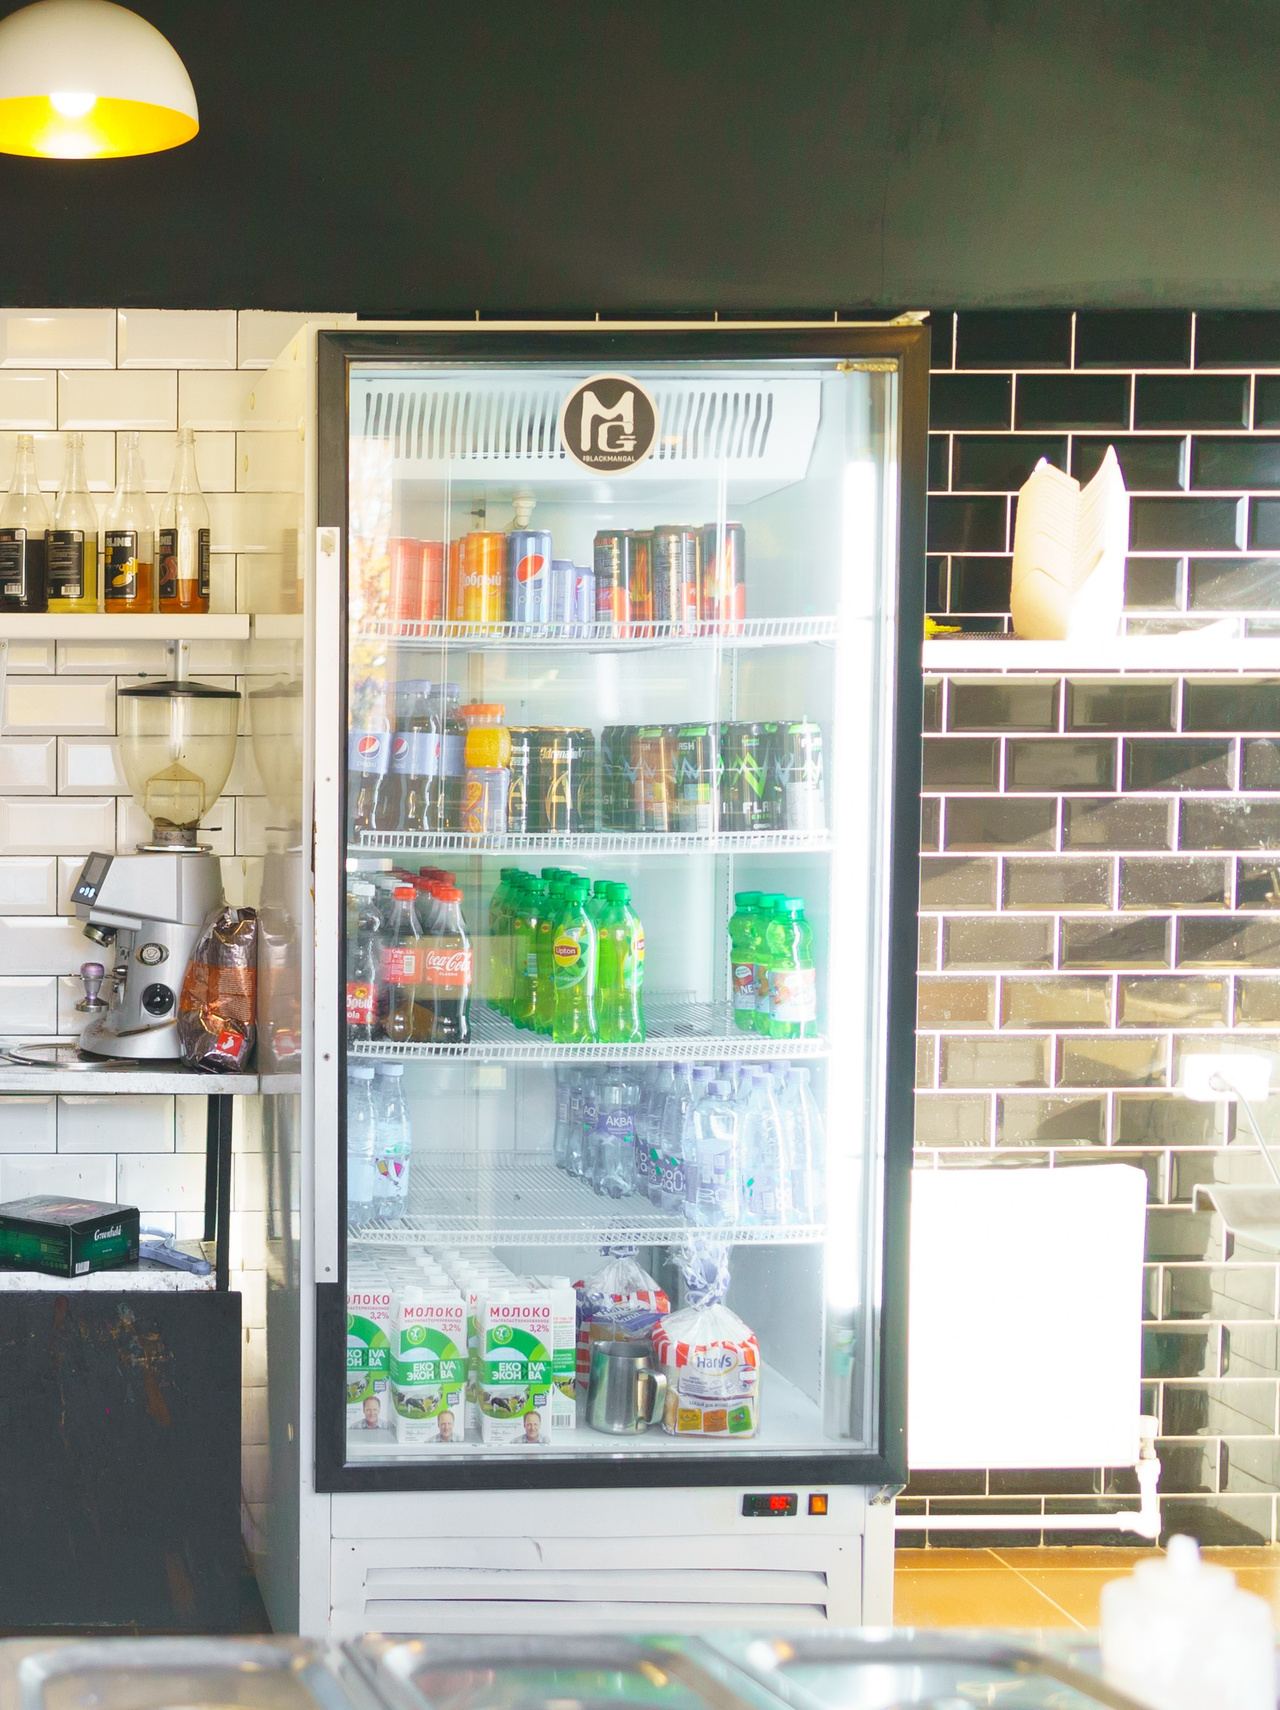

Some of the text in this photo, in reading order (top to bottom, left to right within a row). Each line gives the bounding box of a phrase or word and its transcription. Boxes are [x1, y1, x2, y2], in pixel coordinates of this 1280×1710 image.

[582, 455, 636, 463] #BLACKMANGAL
[555, 945, 576, 955] Lipton
[426, 951, 472, 972] Coca-Cola
[93, 1224, 122, 1241] Greenfield
[370, 1311, 389, 1319] 3,2%
[404, 1307, 463, 1317] МОЛОКО
[490, 1307, 550, 1317] МОЛОКО
[441, 1323, 461, 1332] 3,2%
[529, 1324, 549, 1333] 3,2%
